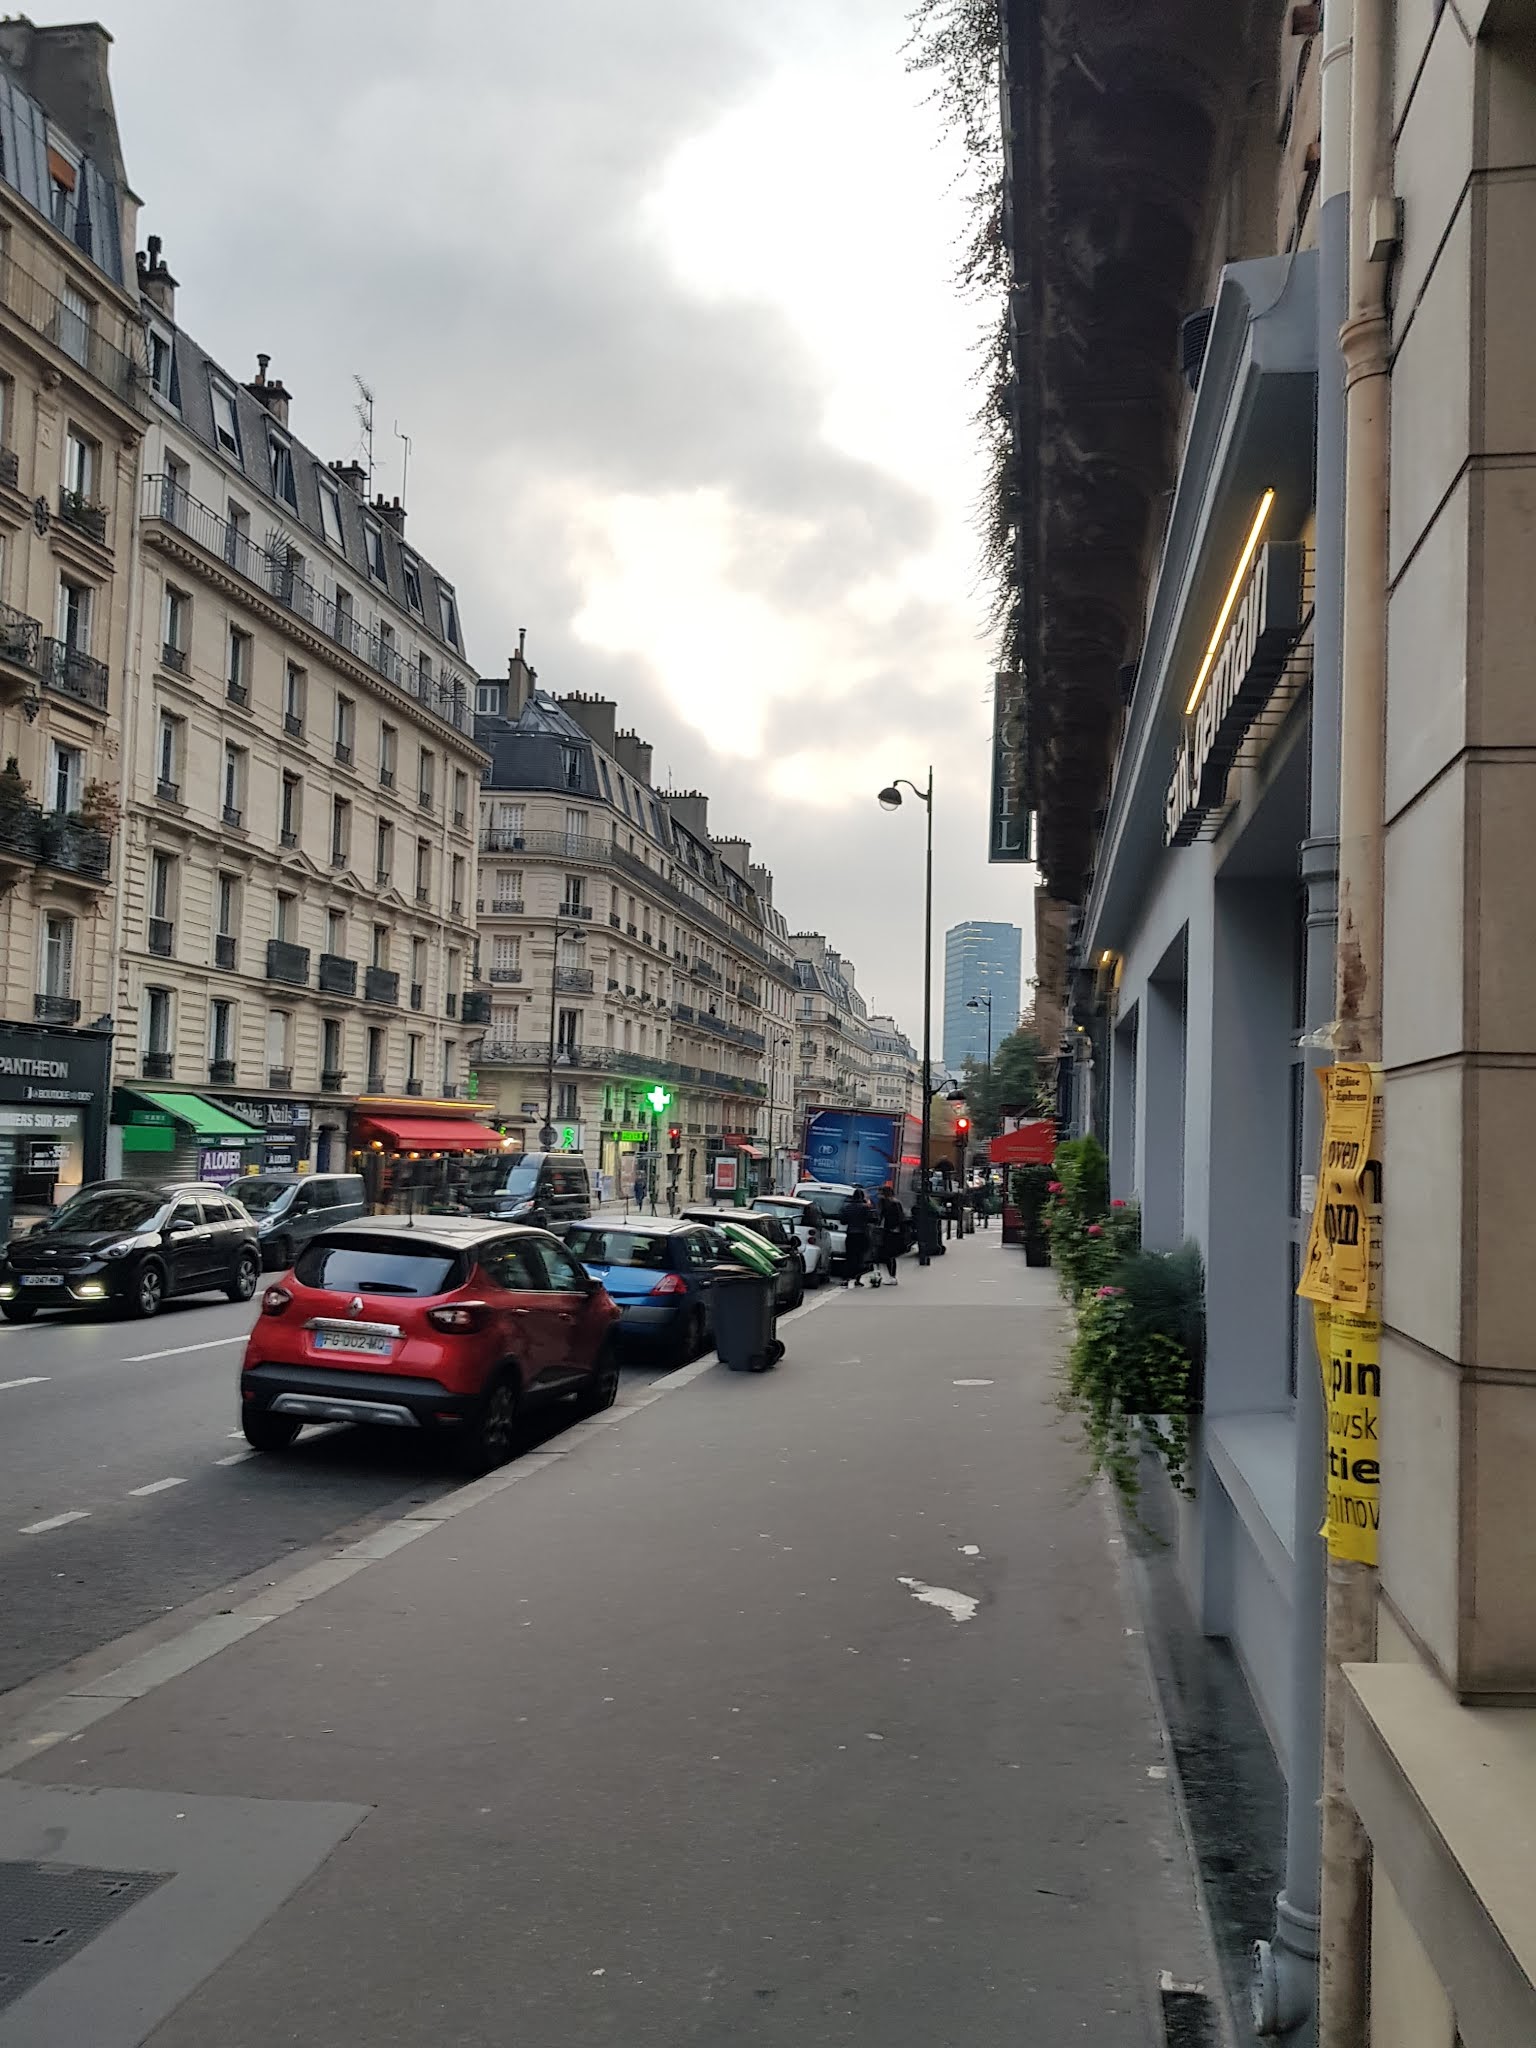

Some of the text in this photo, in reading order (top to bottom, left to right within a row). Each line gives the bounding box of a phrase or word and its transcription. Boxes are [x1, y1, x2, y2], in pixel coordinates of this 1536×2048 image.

[1191, 541, 1269, 809] germain
[212, 1151, 241, 1169] LOUER
[1329, 1446, 1381, 1484] tie
